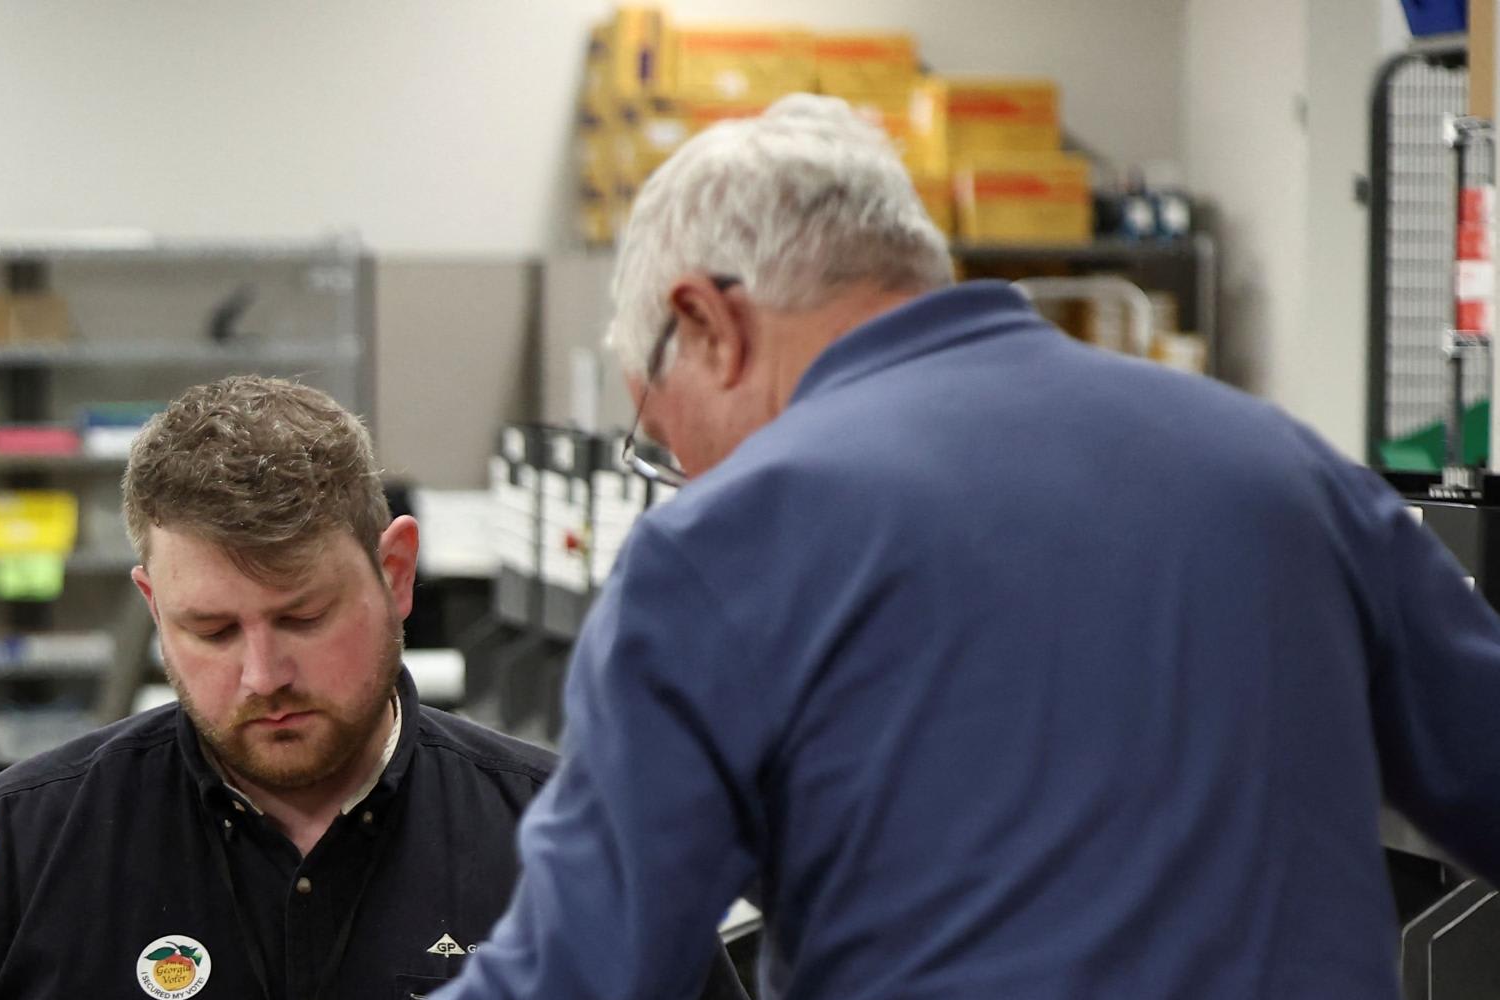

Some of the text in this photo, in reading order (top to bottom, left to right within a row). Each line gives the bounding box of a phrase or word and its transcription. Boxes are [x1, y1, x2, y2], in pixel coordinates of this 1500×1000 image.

[437, 943, 456, 952] GP
[156, 965, 191, 976] Georgia
[162, 976, 187, 984] Voter
[142, 975, 170, 999] SECURED
